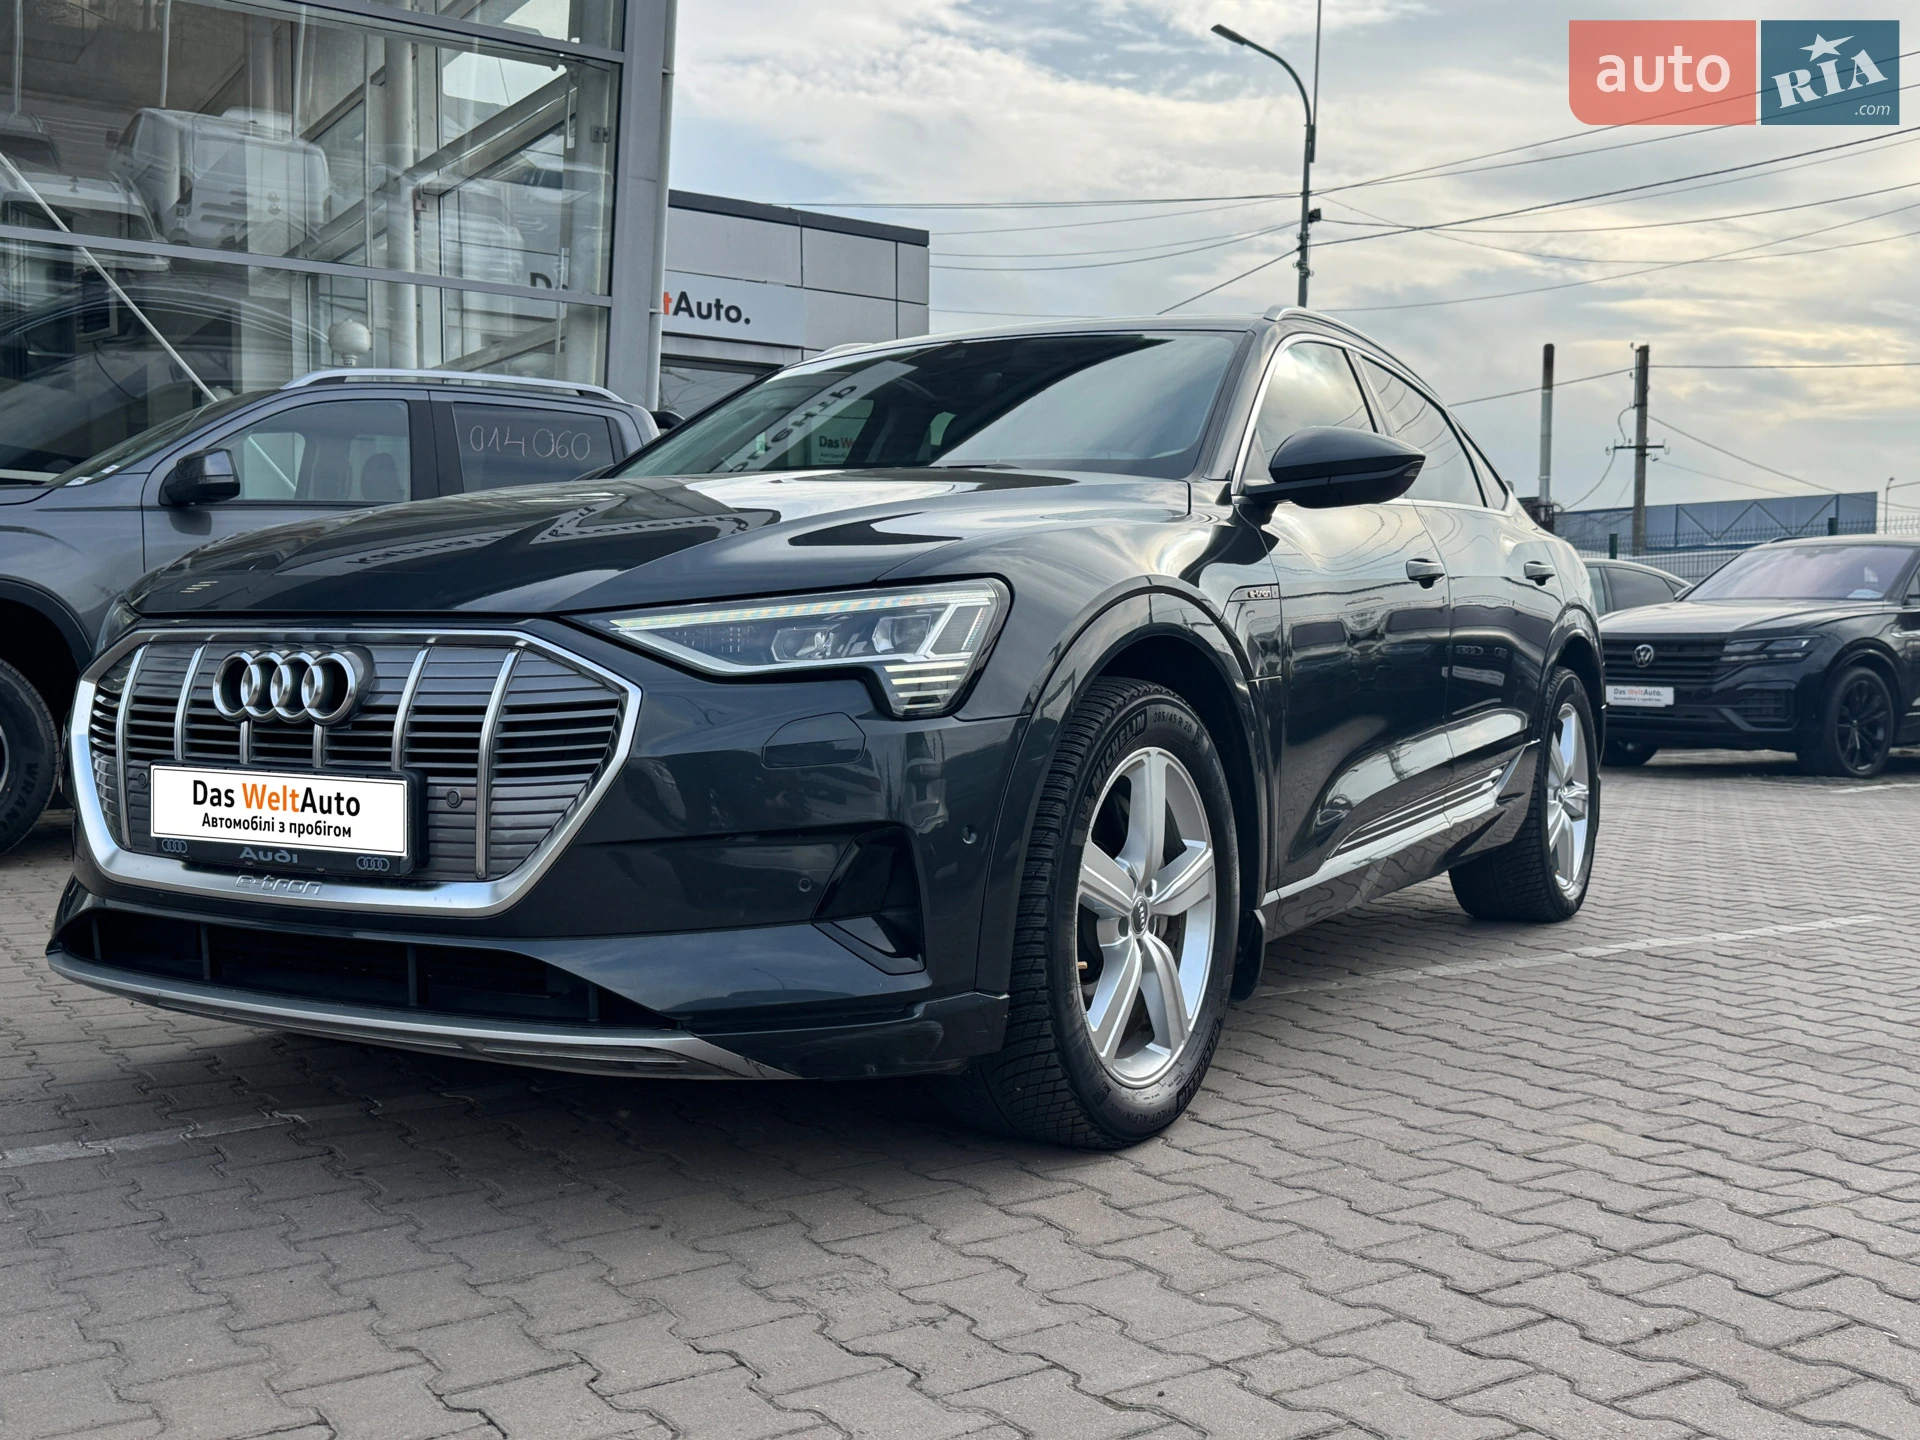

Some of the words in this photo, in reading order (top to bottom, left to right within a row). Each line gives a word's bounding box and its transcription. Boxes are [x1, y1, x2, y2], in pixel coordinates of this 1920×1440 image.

[819, 435, 840, 449] Das
[1092, 713, 1146, 794] MICHELIN
[193, 780, 235, 808] Das
[242, 783, 361, 817] WeltAuto
[202, 812, 275, 832] Автомобілі
[278, 821, 286, 833] з
[289, 820, 352, 838] пробігом
[239, 846, 299, 864] Audi
[235, 874, 323, 895] e-tron
